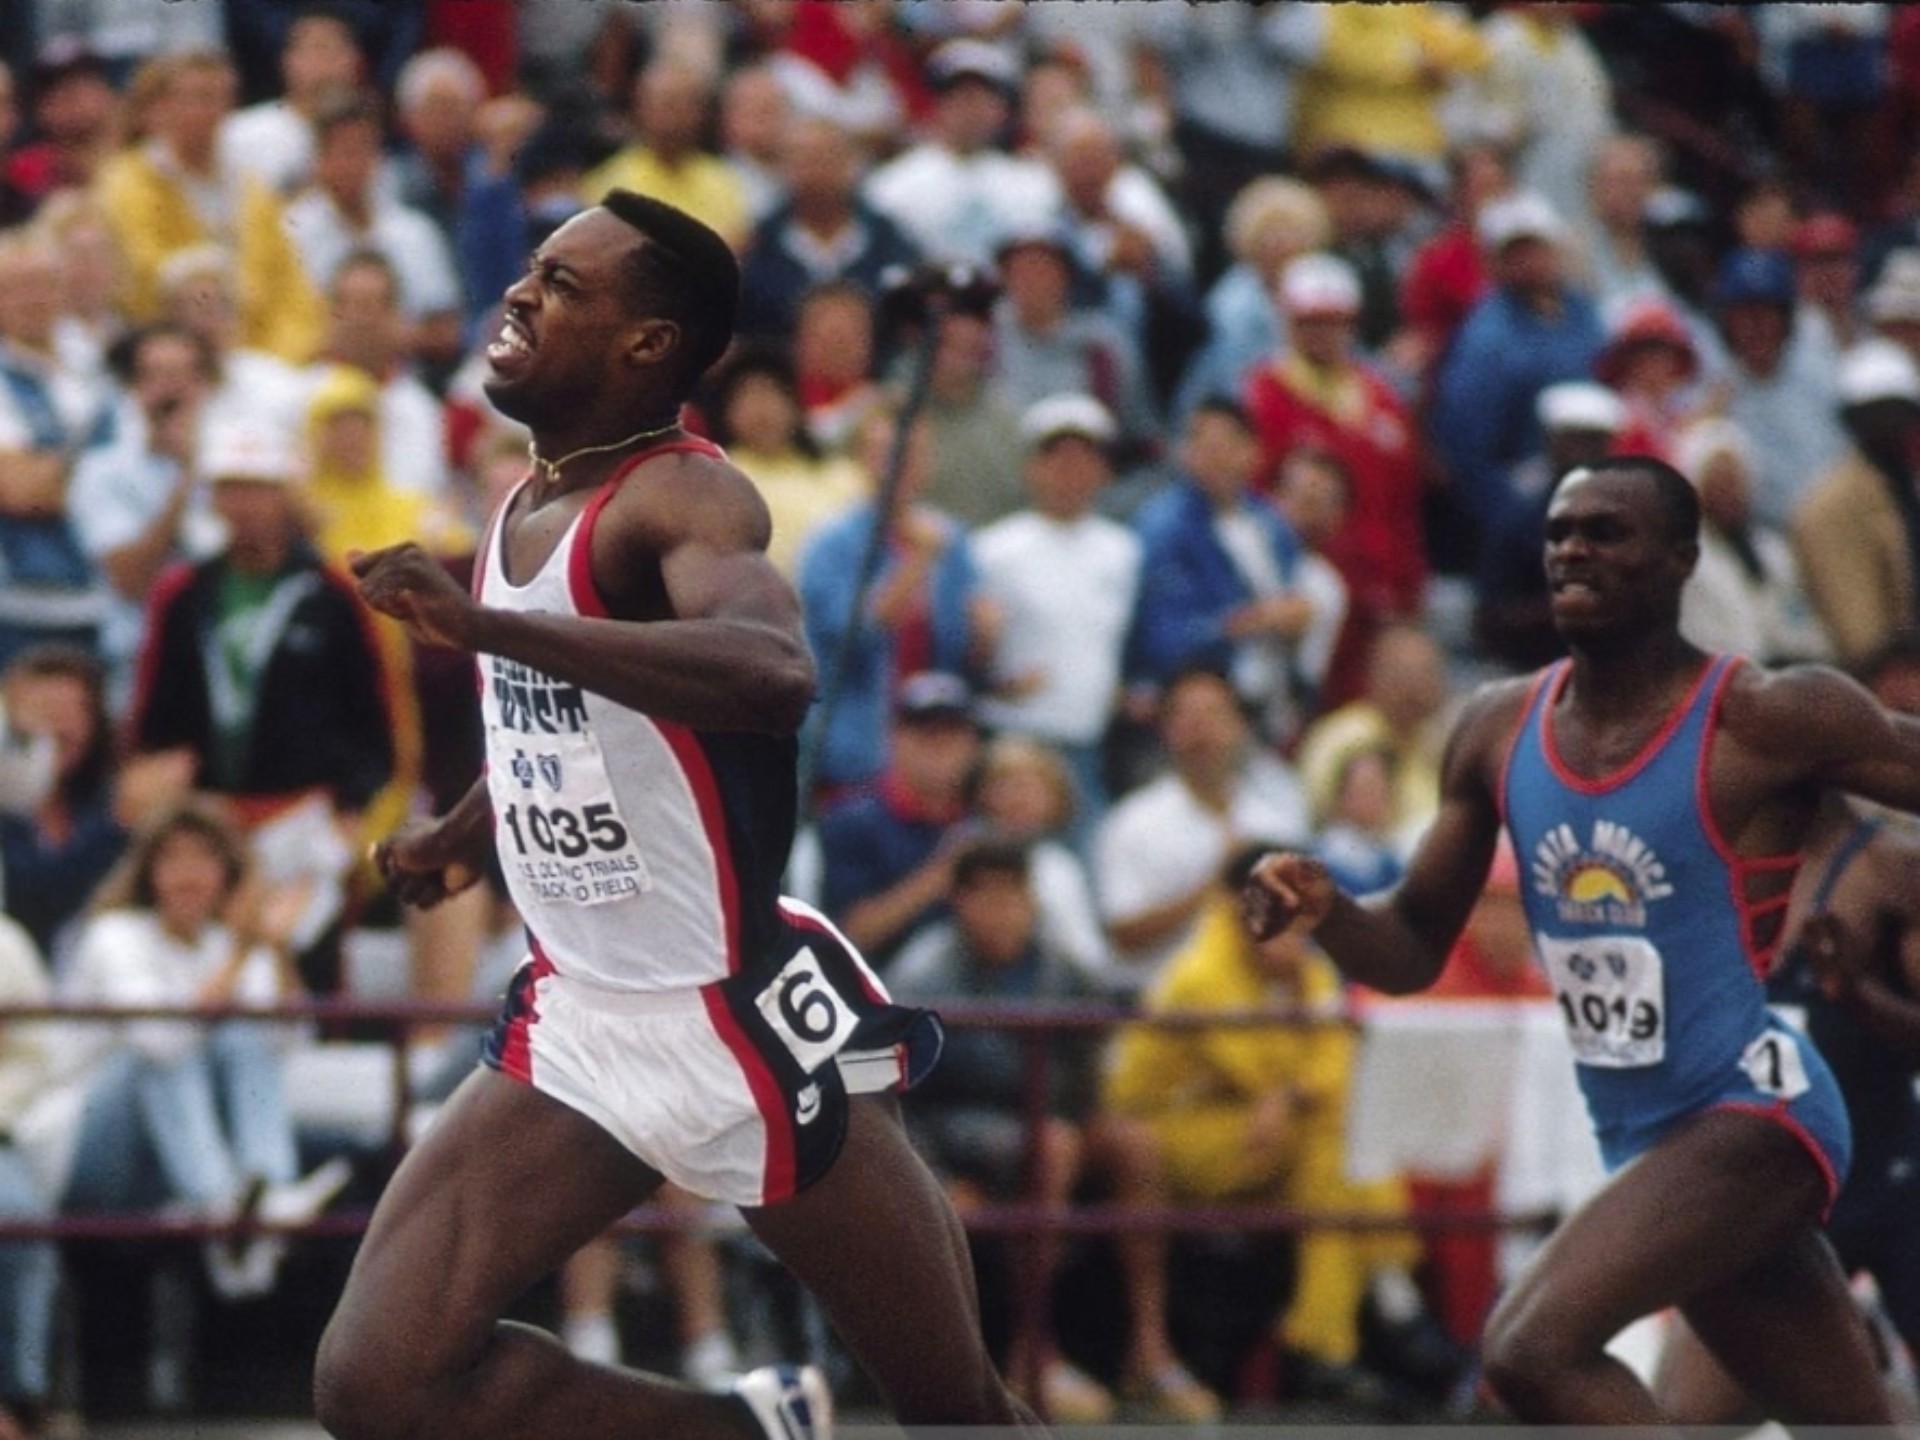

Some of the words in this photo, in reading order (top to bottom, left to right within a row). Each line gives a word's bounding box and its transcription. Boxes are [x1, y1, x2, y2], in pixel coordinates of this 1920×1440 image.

[505, 802, 628, 858] 1035
[585, 854, 639, 877] TRIALS
[593, 876, 637, 897] FIELD
[778, 970, 837, 1043] 6
[1558, 990, 1659, 1040] 1019
